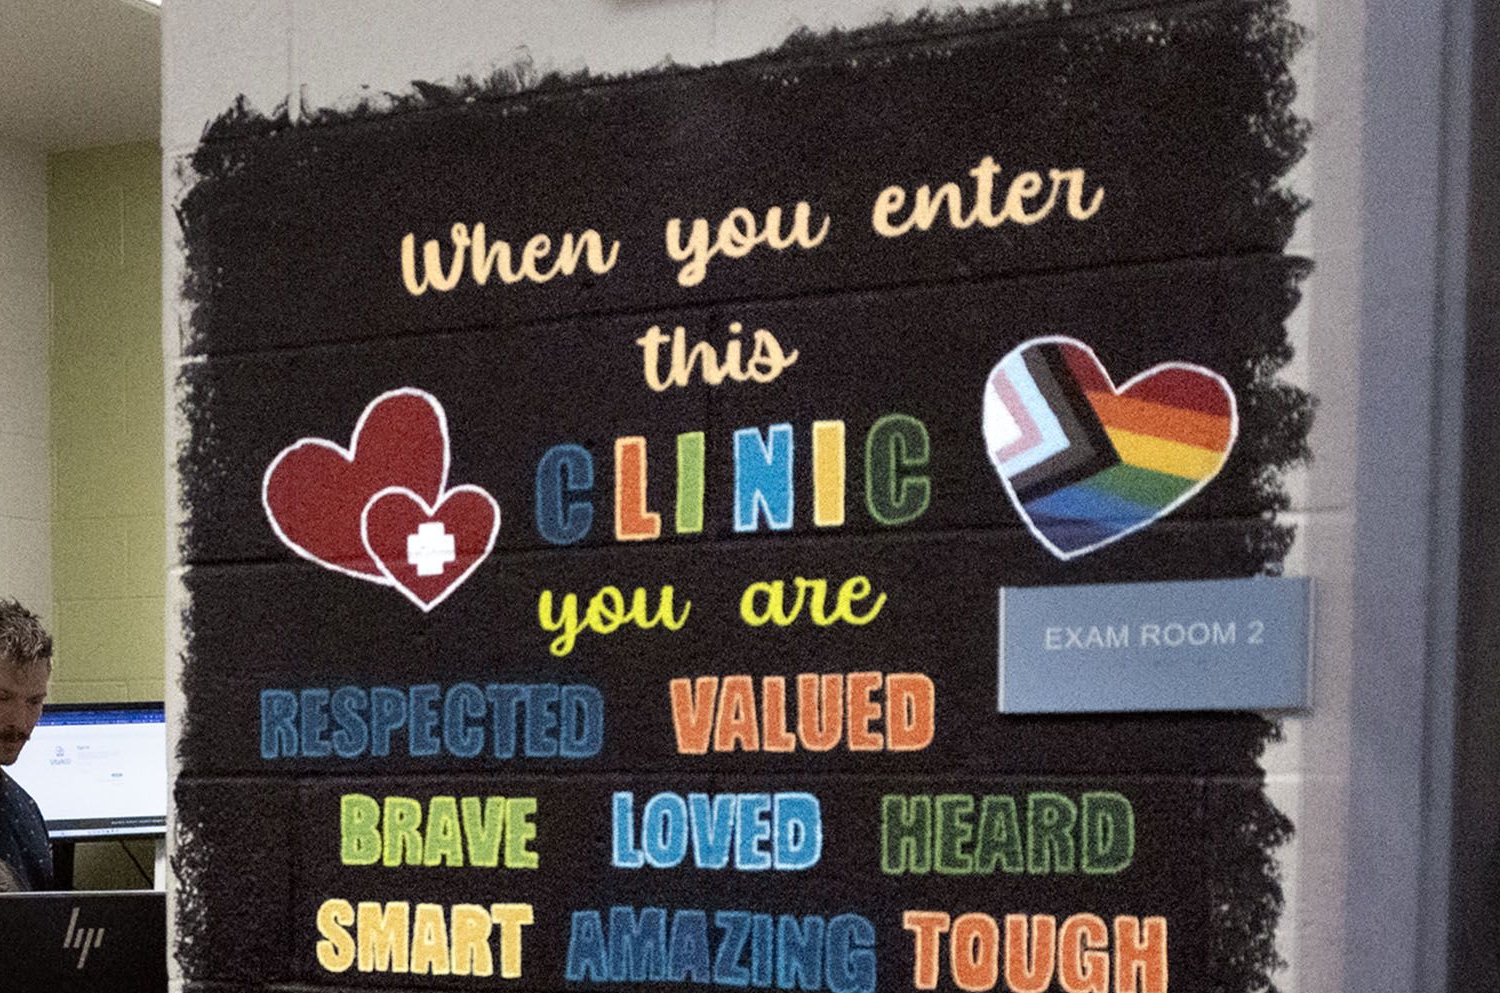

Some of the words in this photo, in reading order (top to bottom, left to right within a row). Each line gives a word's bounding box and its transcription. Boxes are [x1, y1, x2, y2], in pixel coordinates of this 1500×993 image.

[401, 223, 620, 295] When
[666, 202, 829, 286] you
[872, 157, 1104, 237] enter
[637, 322, 798, 391] this
[534, 414, 930, 545] CLINIC
[538, 585, 691, 656] you
[740, 576, 886, 626] are
[1044, 625, 1129, 650] EXAM
[1142, 622, 1237, 646] ROOM
[1248, 620, 1265, 644] 2
[260, 682, 604, 759] RESPECTED
[669, 671, 935, 754] VALUED
[341, 794, 539, 868] BRAVE
[612, 791, 823, 871] LOVED
[881, 791, 1135, 875] HEARD
[63, 907, 105, 970] hp
[316, 899, 534, 978] SMART
